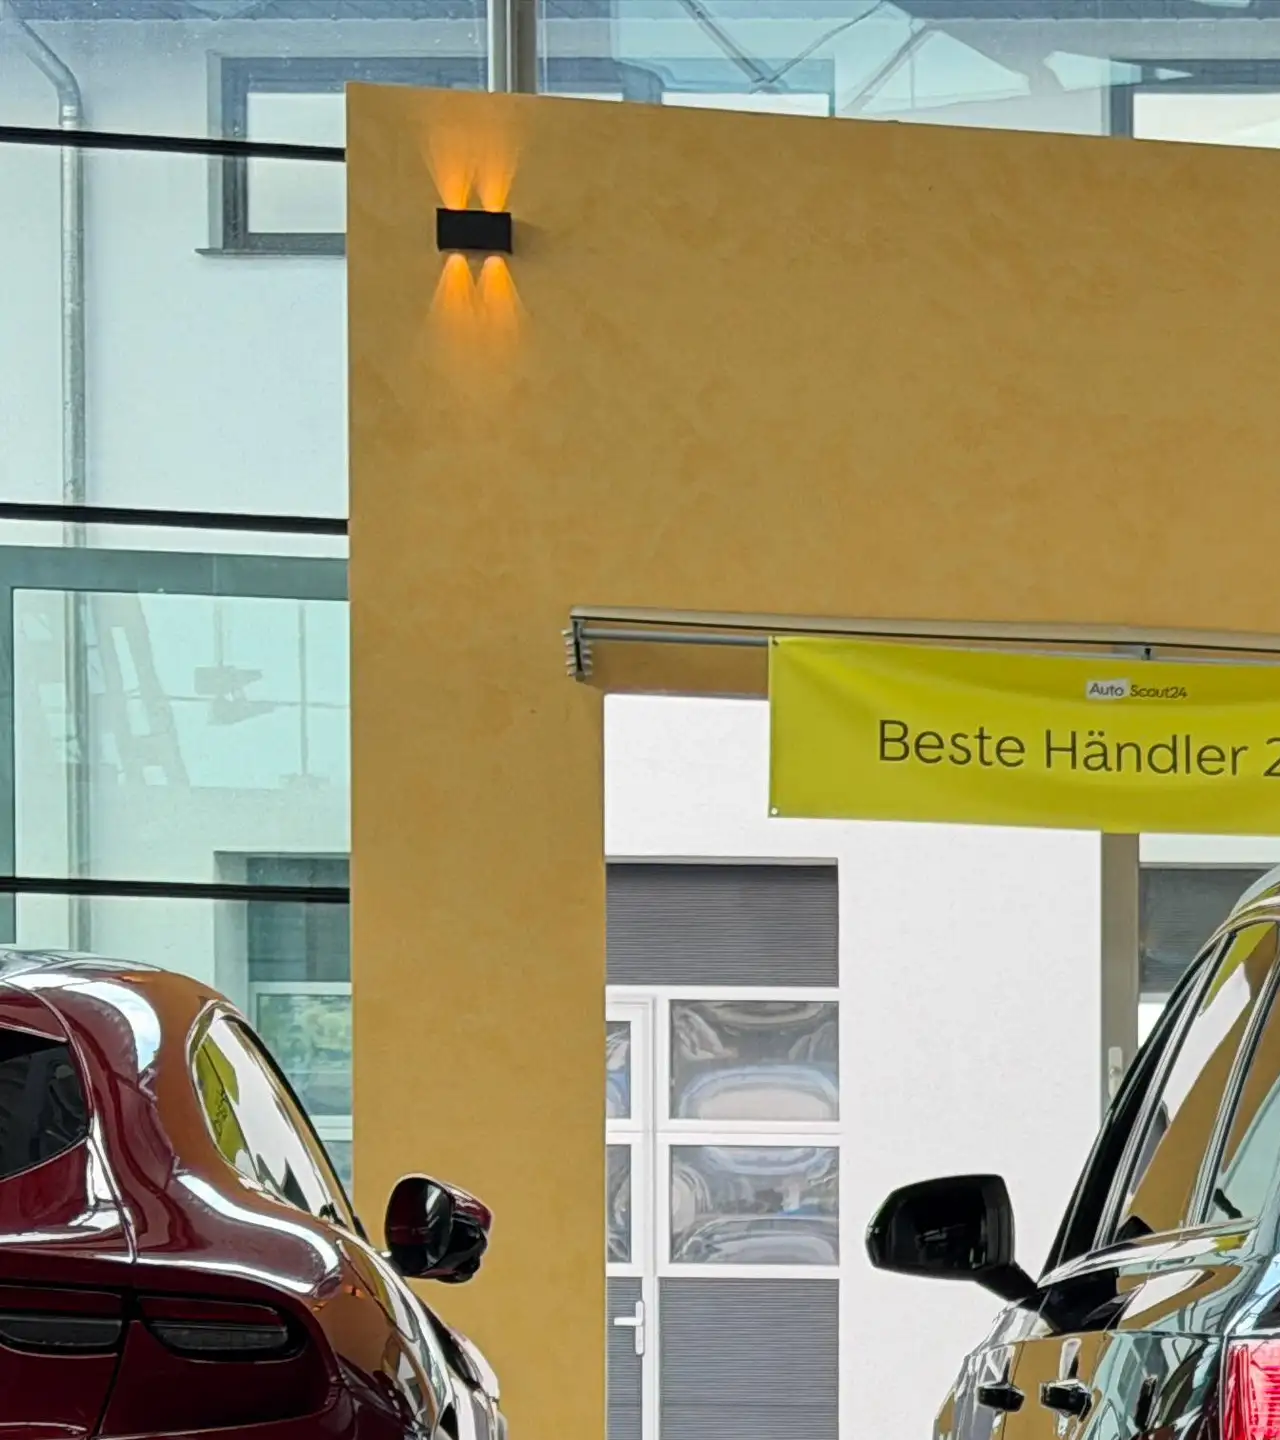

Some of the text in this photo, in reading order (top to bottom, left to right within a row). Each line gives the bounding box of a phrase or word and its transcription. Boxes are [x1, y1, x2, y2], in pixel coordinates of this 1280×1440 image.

[1089, 682, 1188, 698] Auto Scout24
[879, 719, 1026, 768] Beste
[1045, 728, 1249, 776] Händler
